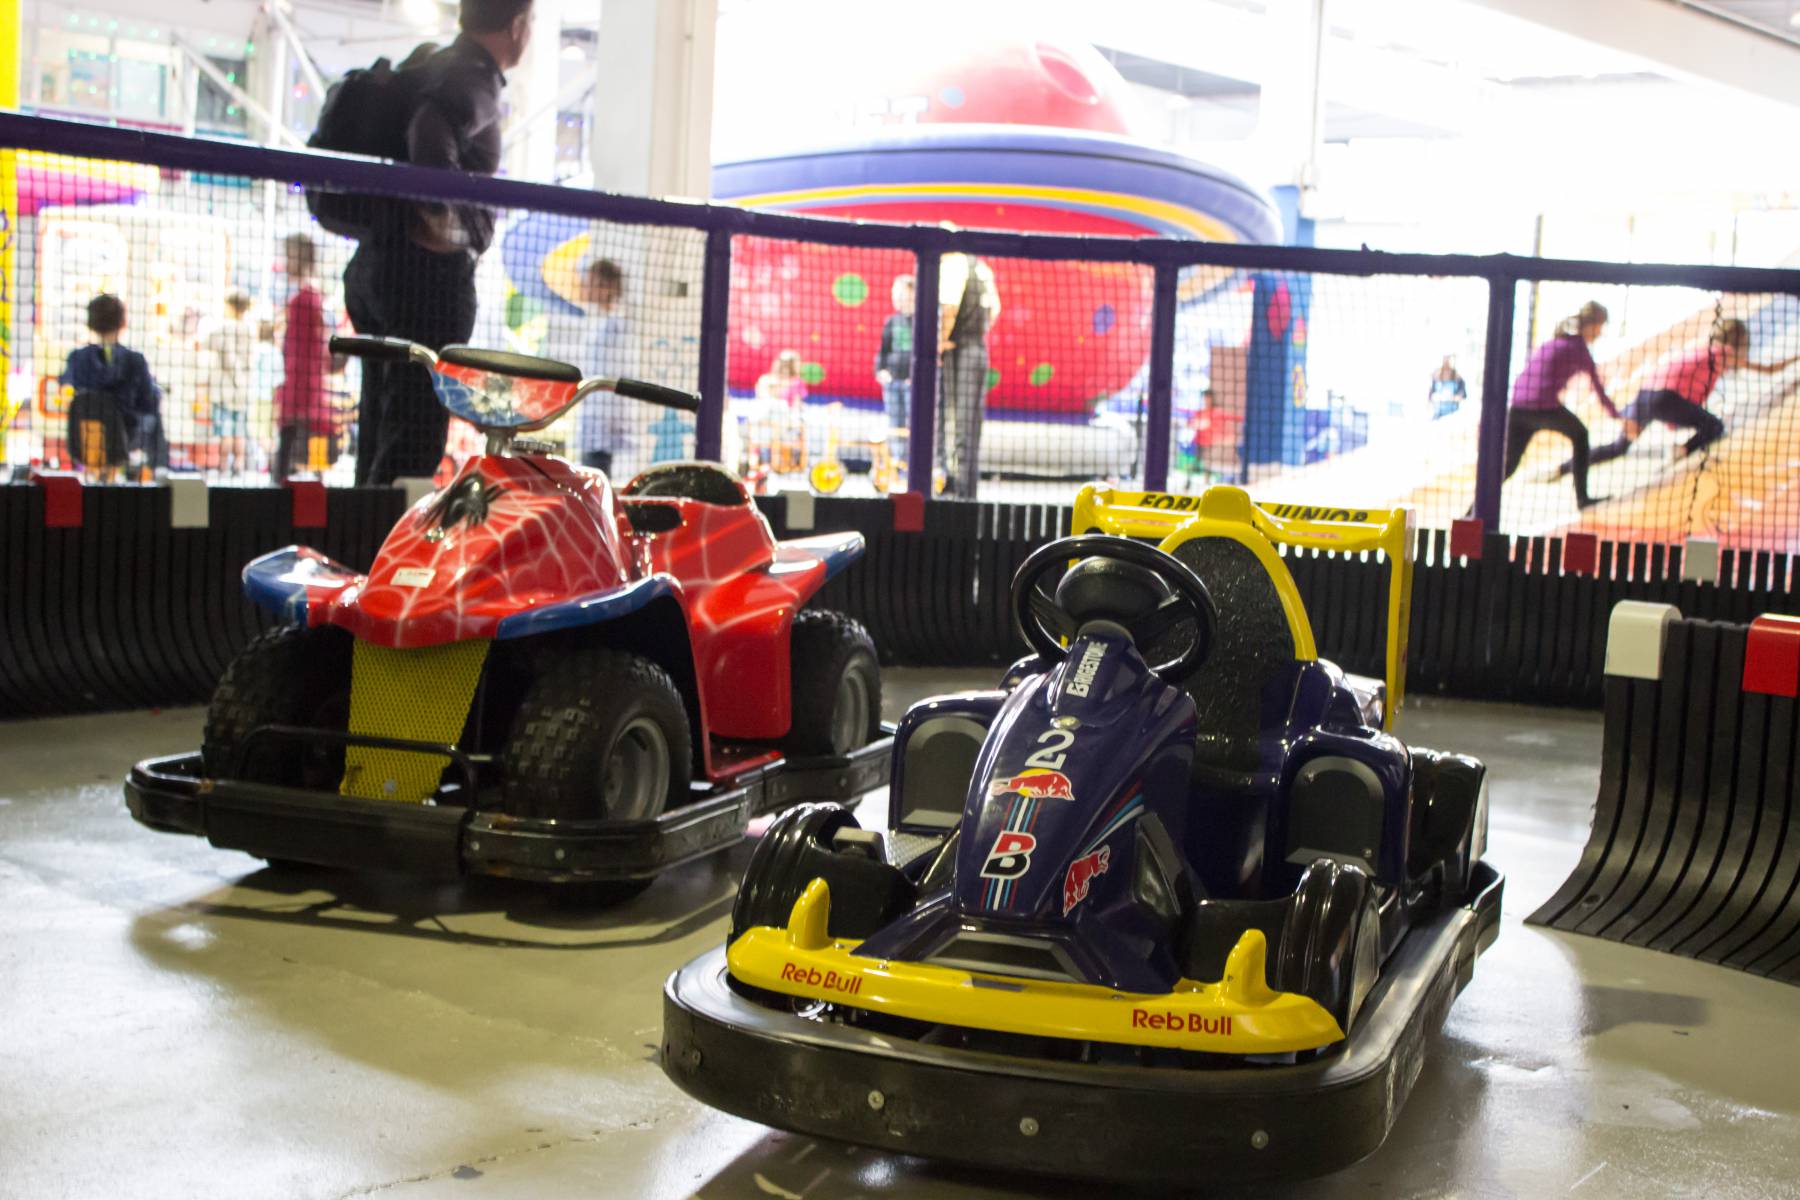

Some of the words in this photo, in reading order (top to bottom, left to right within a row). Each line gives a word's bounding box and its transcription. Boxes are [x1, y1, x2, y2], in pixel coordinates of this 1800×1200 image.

[1025, 729, 1075, 770] 2
[980, 830, 1036, 879] B
[781, 962, 822, 986] Reb
[823, 971, 862, 994] Bull
[1132, 1008, 1184, 1031] Reb
[1188, 1013, 1231, 1035] Bull
